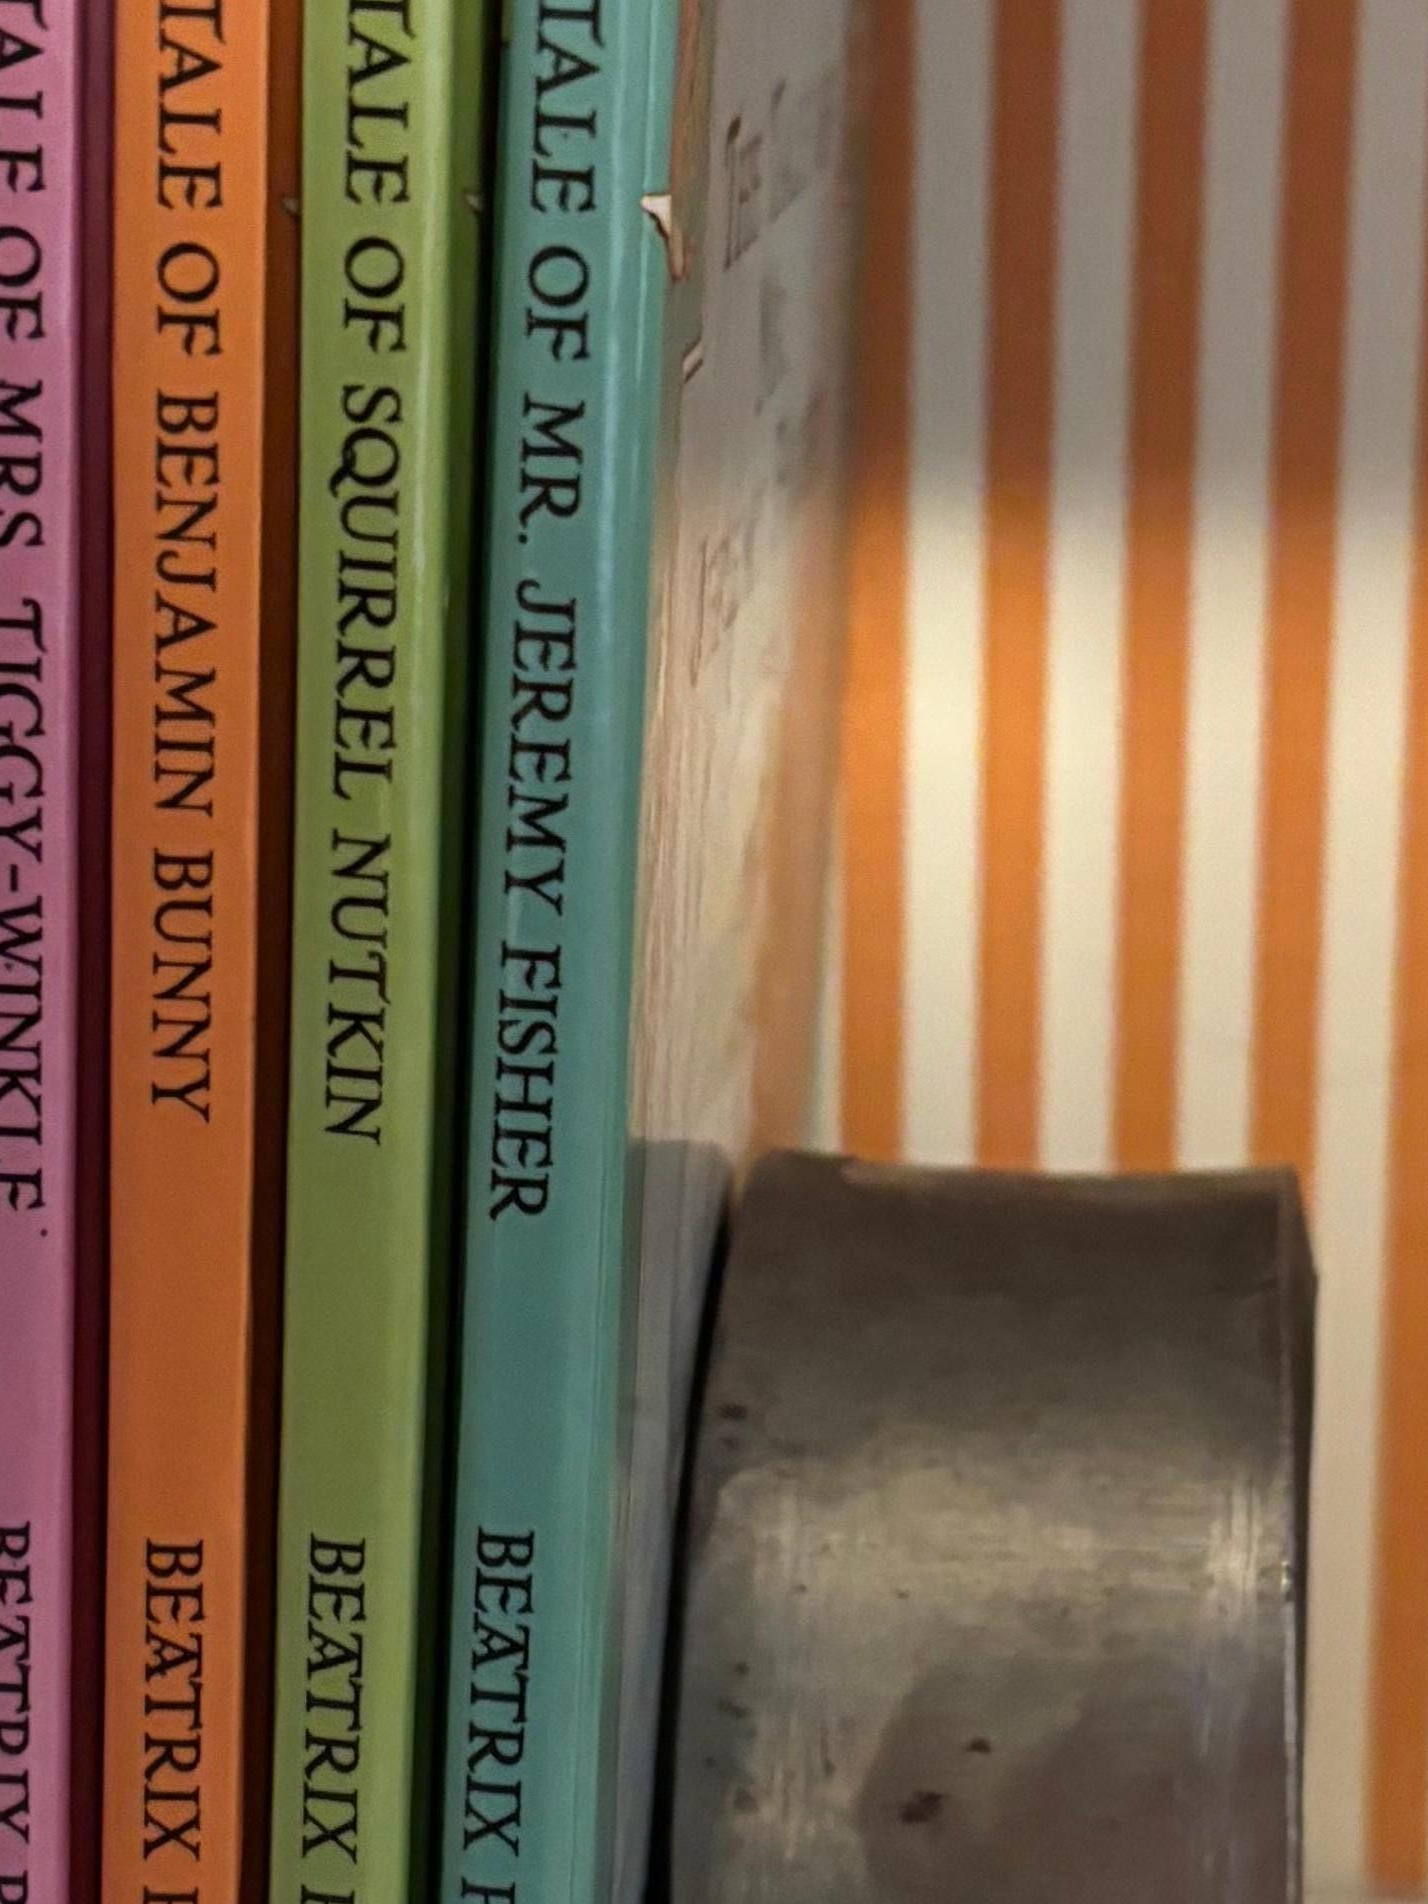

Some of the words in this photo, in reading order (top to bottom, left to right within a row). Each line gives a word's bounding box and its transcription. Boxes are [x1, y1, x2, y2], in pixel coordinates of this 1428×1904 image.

[157, 241, 222, 356] OF
[343, 236, 407, 353] OF
[526, 245, 590, 361] OF
[154, 390, 220, 817] BENJAMIN
[328, 385, 403, 800] SQUIRREL
[518, 392, 585, 544] MR.
[504, 579, 577, 916] JEREMY
[151, 848, 214, 1123] BUNNY
[324, 828, 391, 1146] NUTKIN
[489, 941, 562, 1221] FISHER
[143, 1538, 205, 1860] BEATRIX
[300, 1533, 367, 1860] BEATRIX
[463, 1527, 535, 1860] BEATRIX
